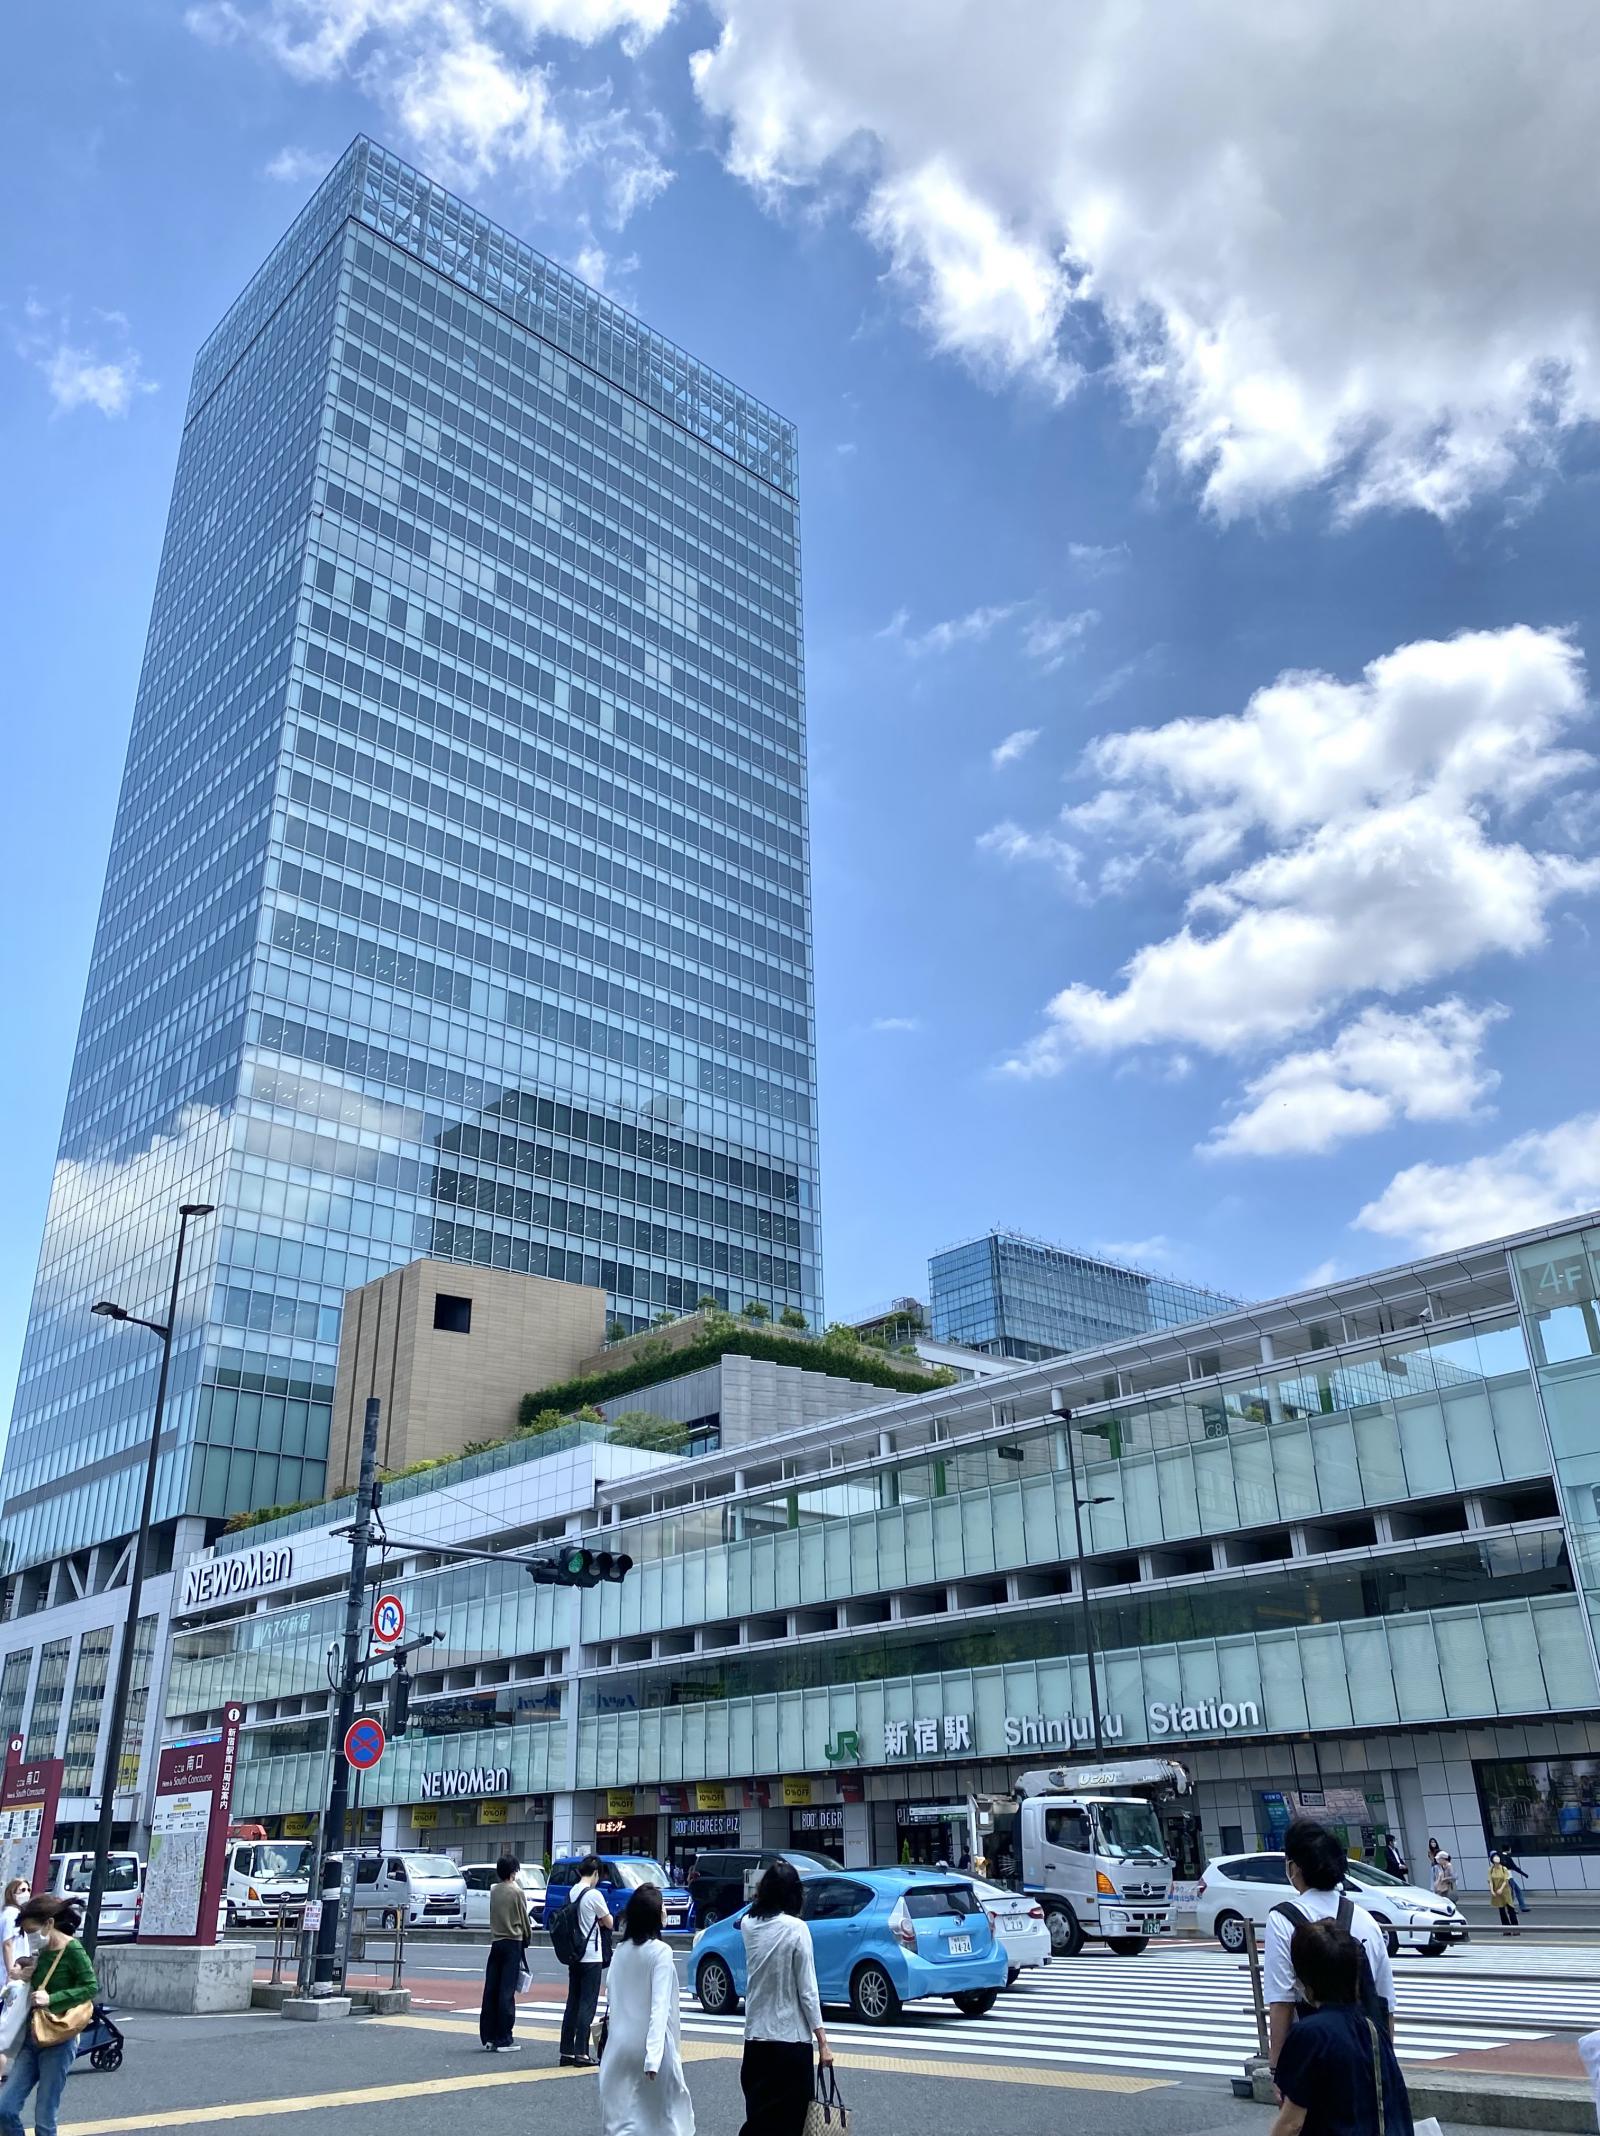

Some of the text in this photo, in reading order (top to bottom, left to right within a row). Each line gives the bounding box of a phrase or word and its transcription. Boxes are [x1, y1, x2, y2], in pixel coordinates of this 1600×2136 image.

[1540, 1262, 1581, 1294] 4F
[1206, 1423, 1223, 1438] C8
[184, 1547, 292, 1605] NEWoMan
[885, 1714, 972, 1756] 新宿駅
[1004, 1697, 1260, 1749] Shinjuku Station
[825, 1731, 860, 1761] JR
[186, 1754, 204, 1771] 南口
[219, 1728, 237, 1810] 新宿駅南口周辺案内
[173, 1775, 187, 1786] South
[187, 1774, 213, 1784] Concourse
[420, 1767, 510, 1798] NEWoMan
[690, 1818, 723, 1833] DEGREES
[726, 1817, 741, 1832] PIZ
